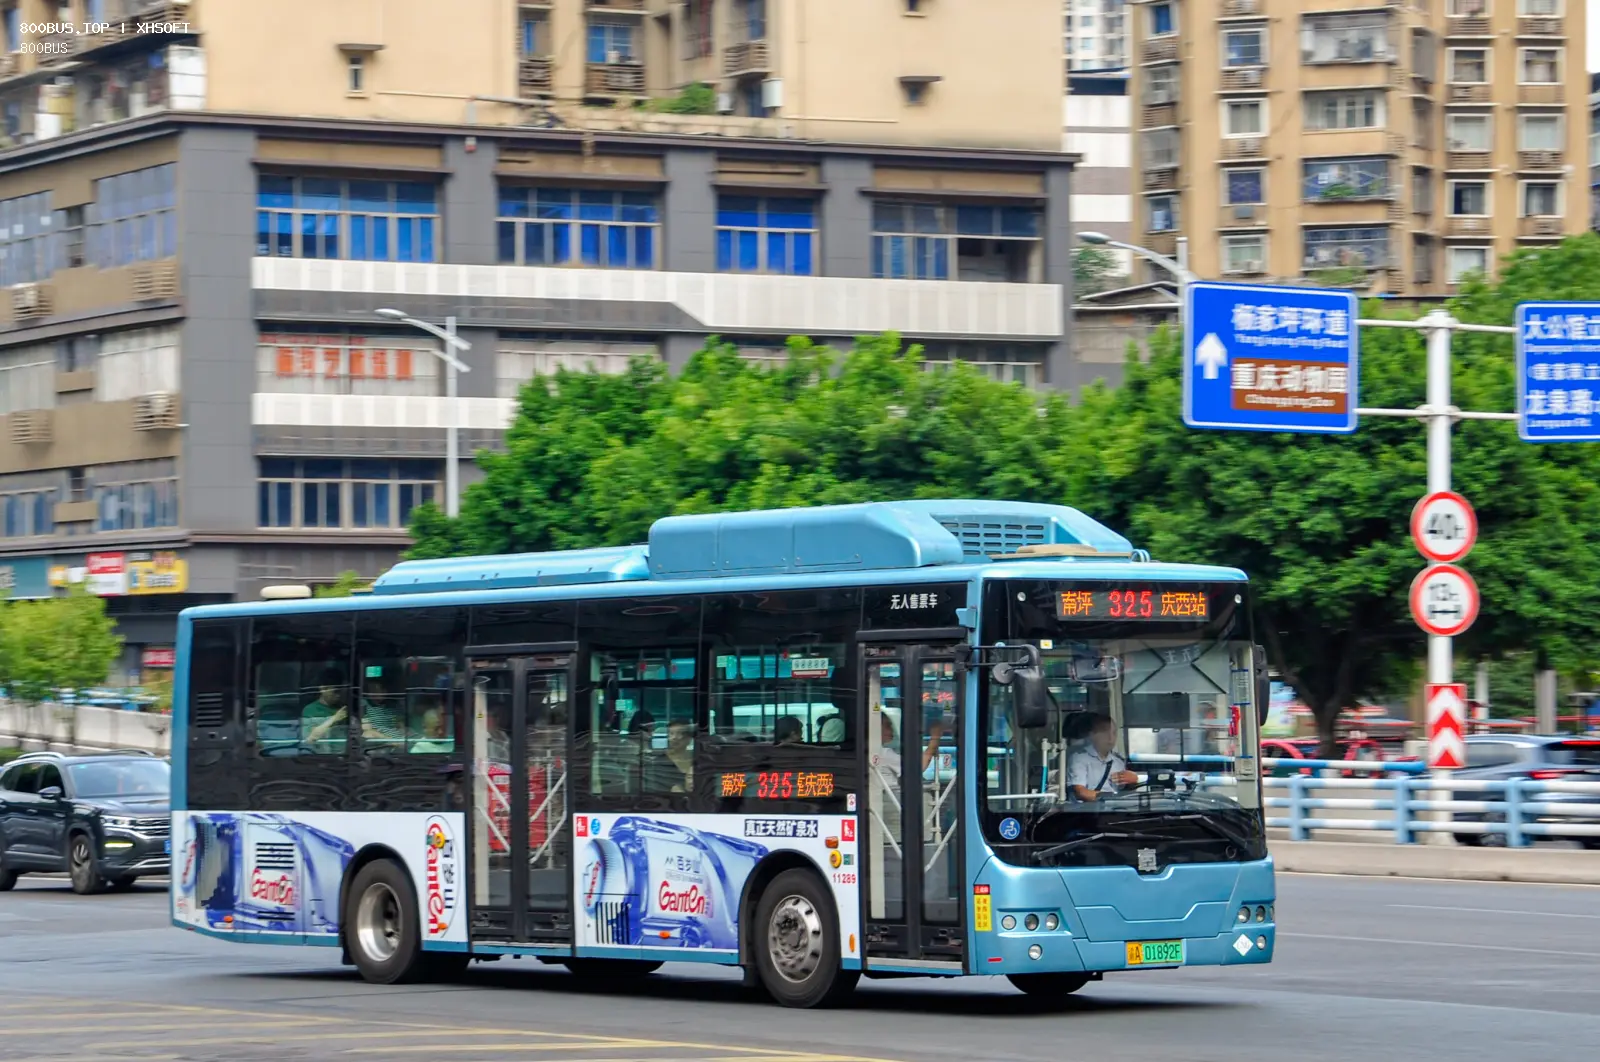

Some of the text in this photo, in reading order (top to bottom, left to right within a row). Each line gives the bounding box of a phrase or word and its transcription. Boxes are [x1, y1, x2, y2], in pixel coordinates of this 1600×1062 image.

[890, 592, 938, 610] 无人售票车
[1060, 590, 1093, 616] 南坪
[1108, 589, 1153, 618] 325
[721, 773, 747, 797] 南坪
[757, 772, 793, 799] 325
[745, 820, 818, 837] 真正天然矿泉水
[832, 873, 857, 884] 11289
